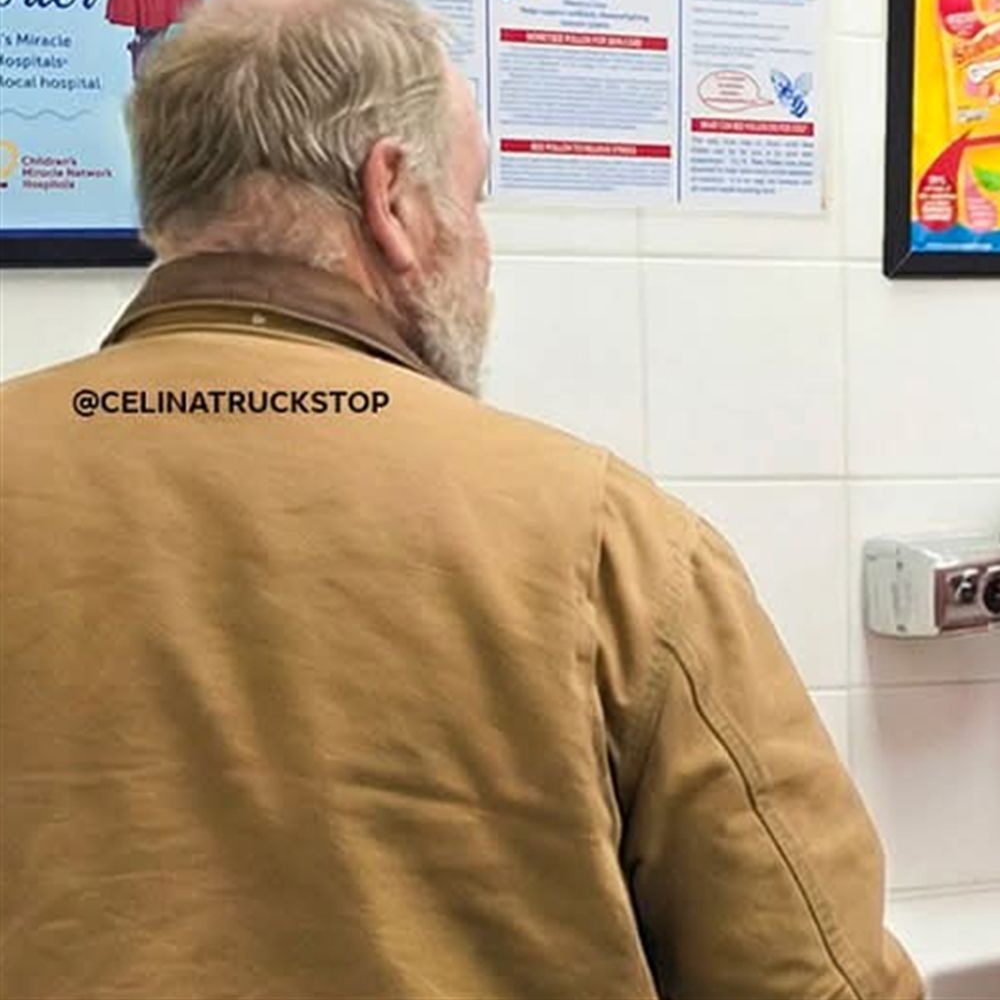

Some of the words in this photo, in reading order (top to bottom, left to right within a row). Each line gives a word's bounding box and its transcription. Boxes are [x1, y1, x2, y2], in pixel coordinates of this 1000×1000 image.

[17, 33, 72, 48] Miracle
[40, 76, 101, 92] hospital
[66, 168, 113, 179] Network
